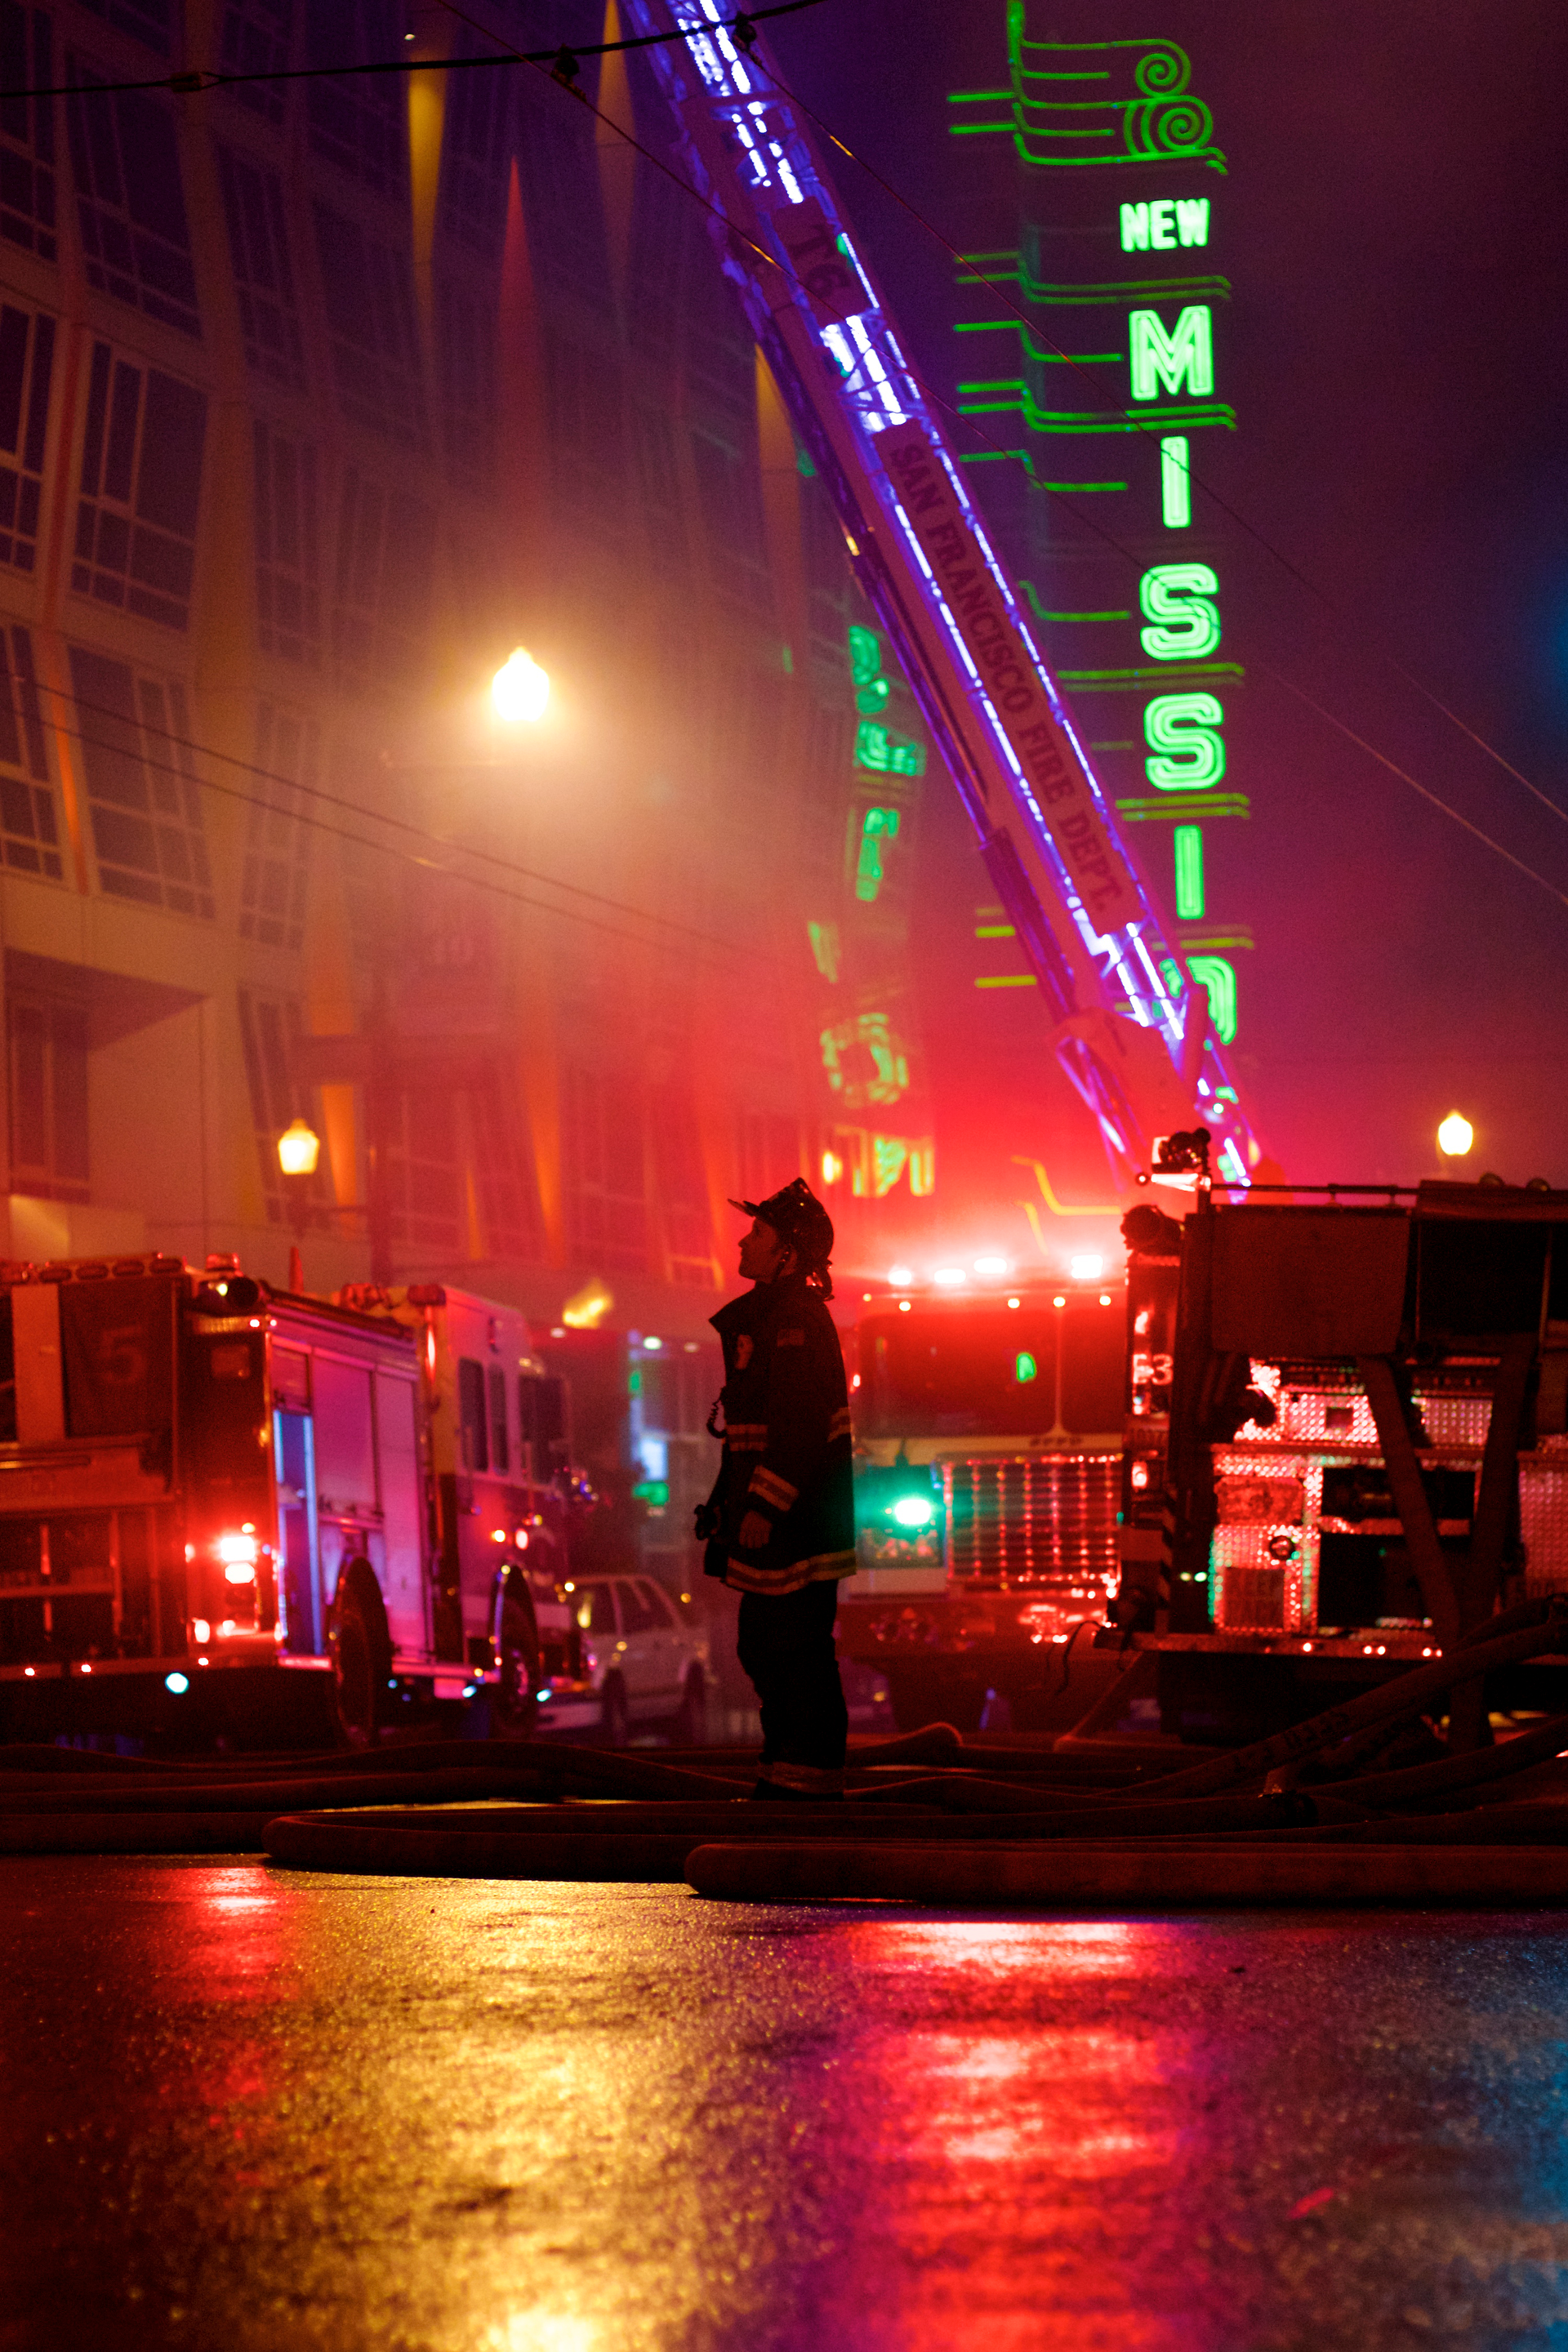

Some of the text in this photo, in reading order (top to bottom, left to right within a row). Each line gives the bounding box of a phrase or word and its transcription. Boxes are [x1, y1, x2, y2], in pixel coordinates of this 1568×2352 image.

[1120, 198, 1210, 253] NEW
[889, 442, 944, 514] SAN
[923, 520, 1037, 716] FRANCISCO
[1017, 722, 1076, 803] FIRE
[98, 1326, 149, 1384] 5
